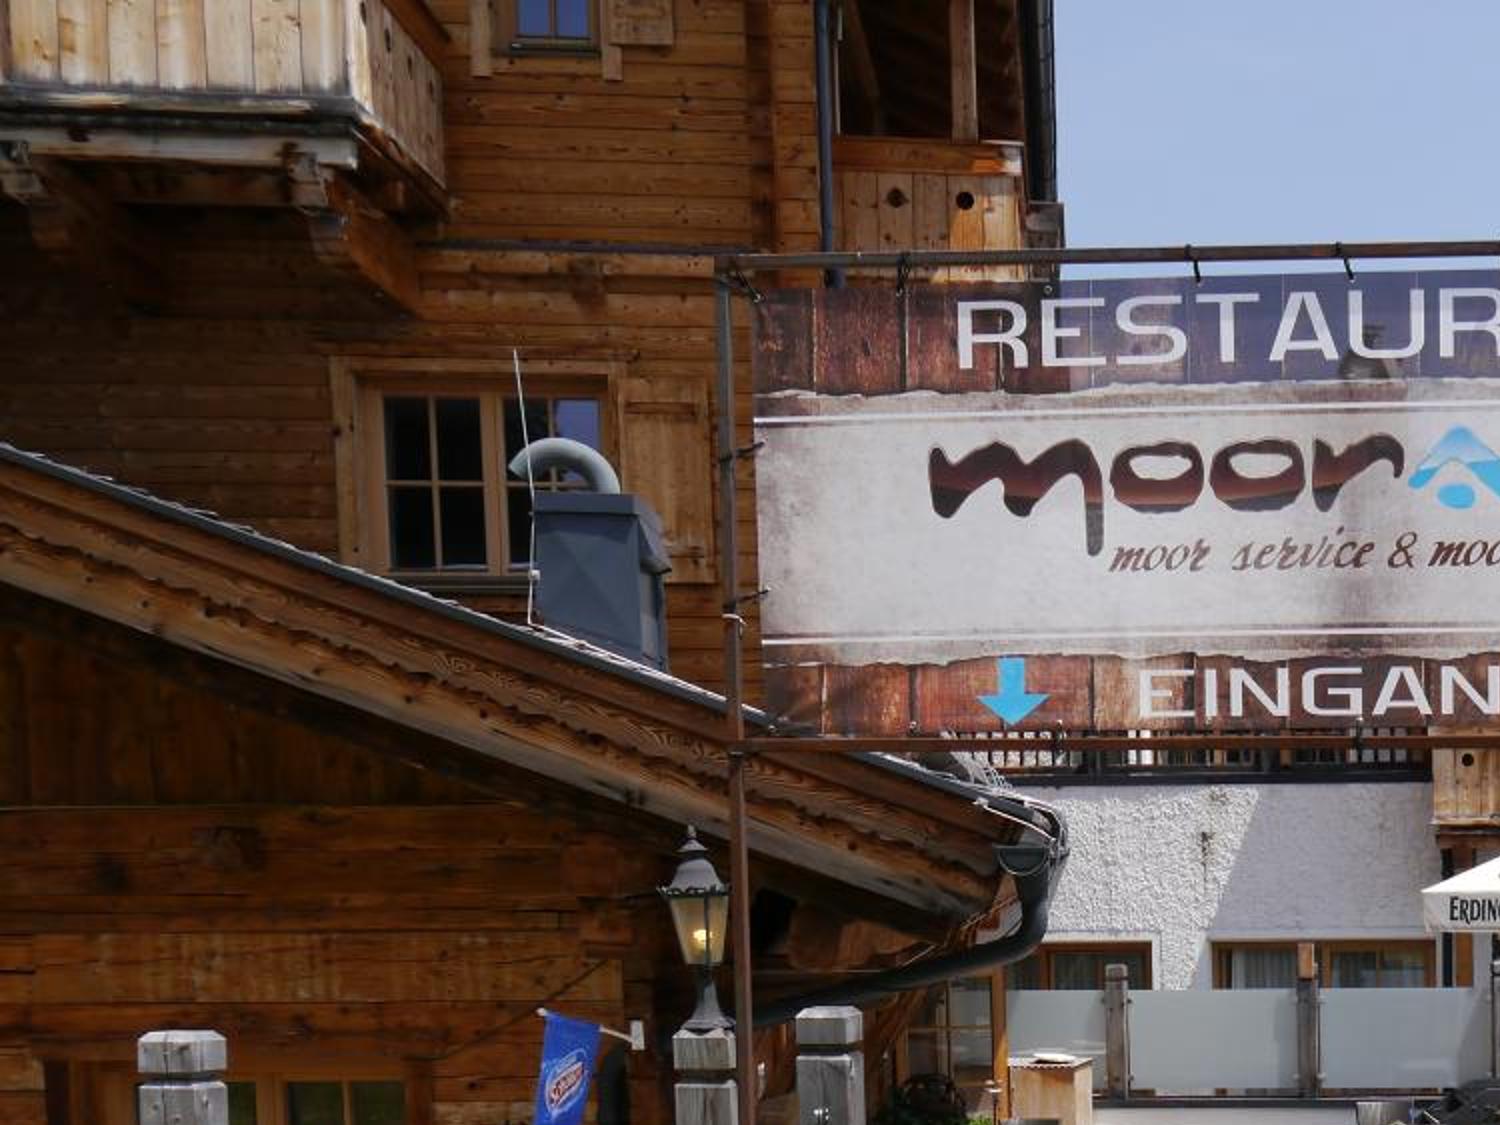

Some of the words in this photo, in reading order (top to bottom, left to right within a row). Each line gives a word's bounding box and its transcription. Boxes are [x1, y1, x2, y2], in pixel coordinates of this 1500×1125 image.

[1109, 538, 1211, 572] moor
[1232, 526, 1375, 571] service
[1388, 531, 1418, 568] &
